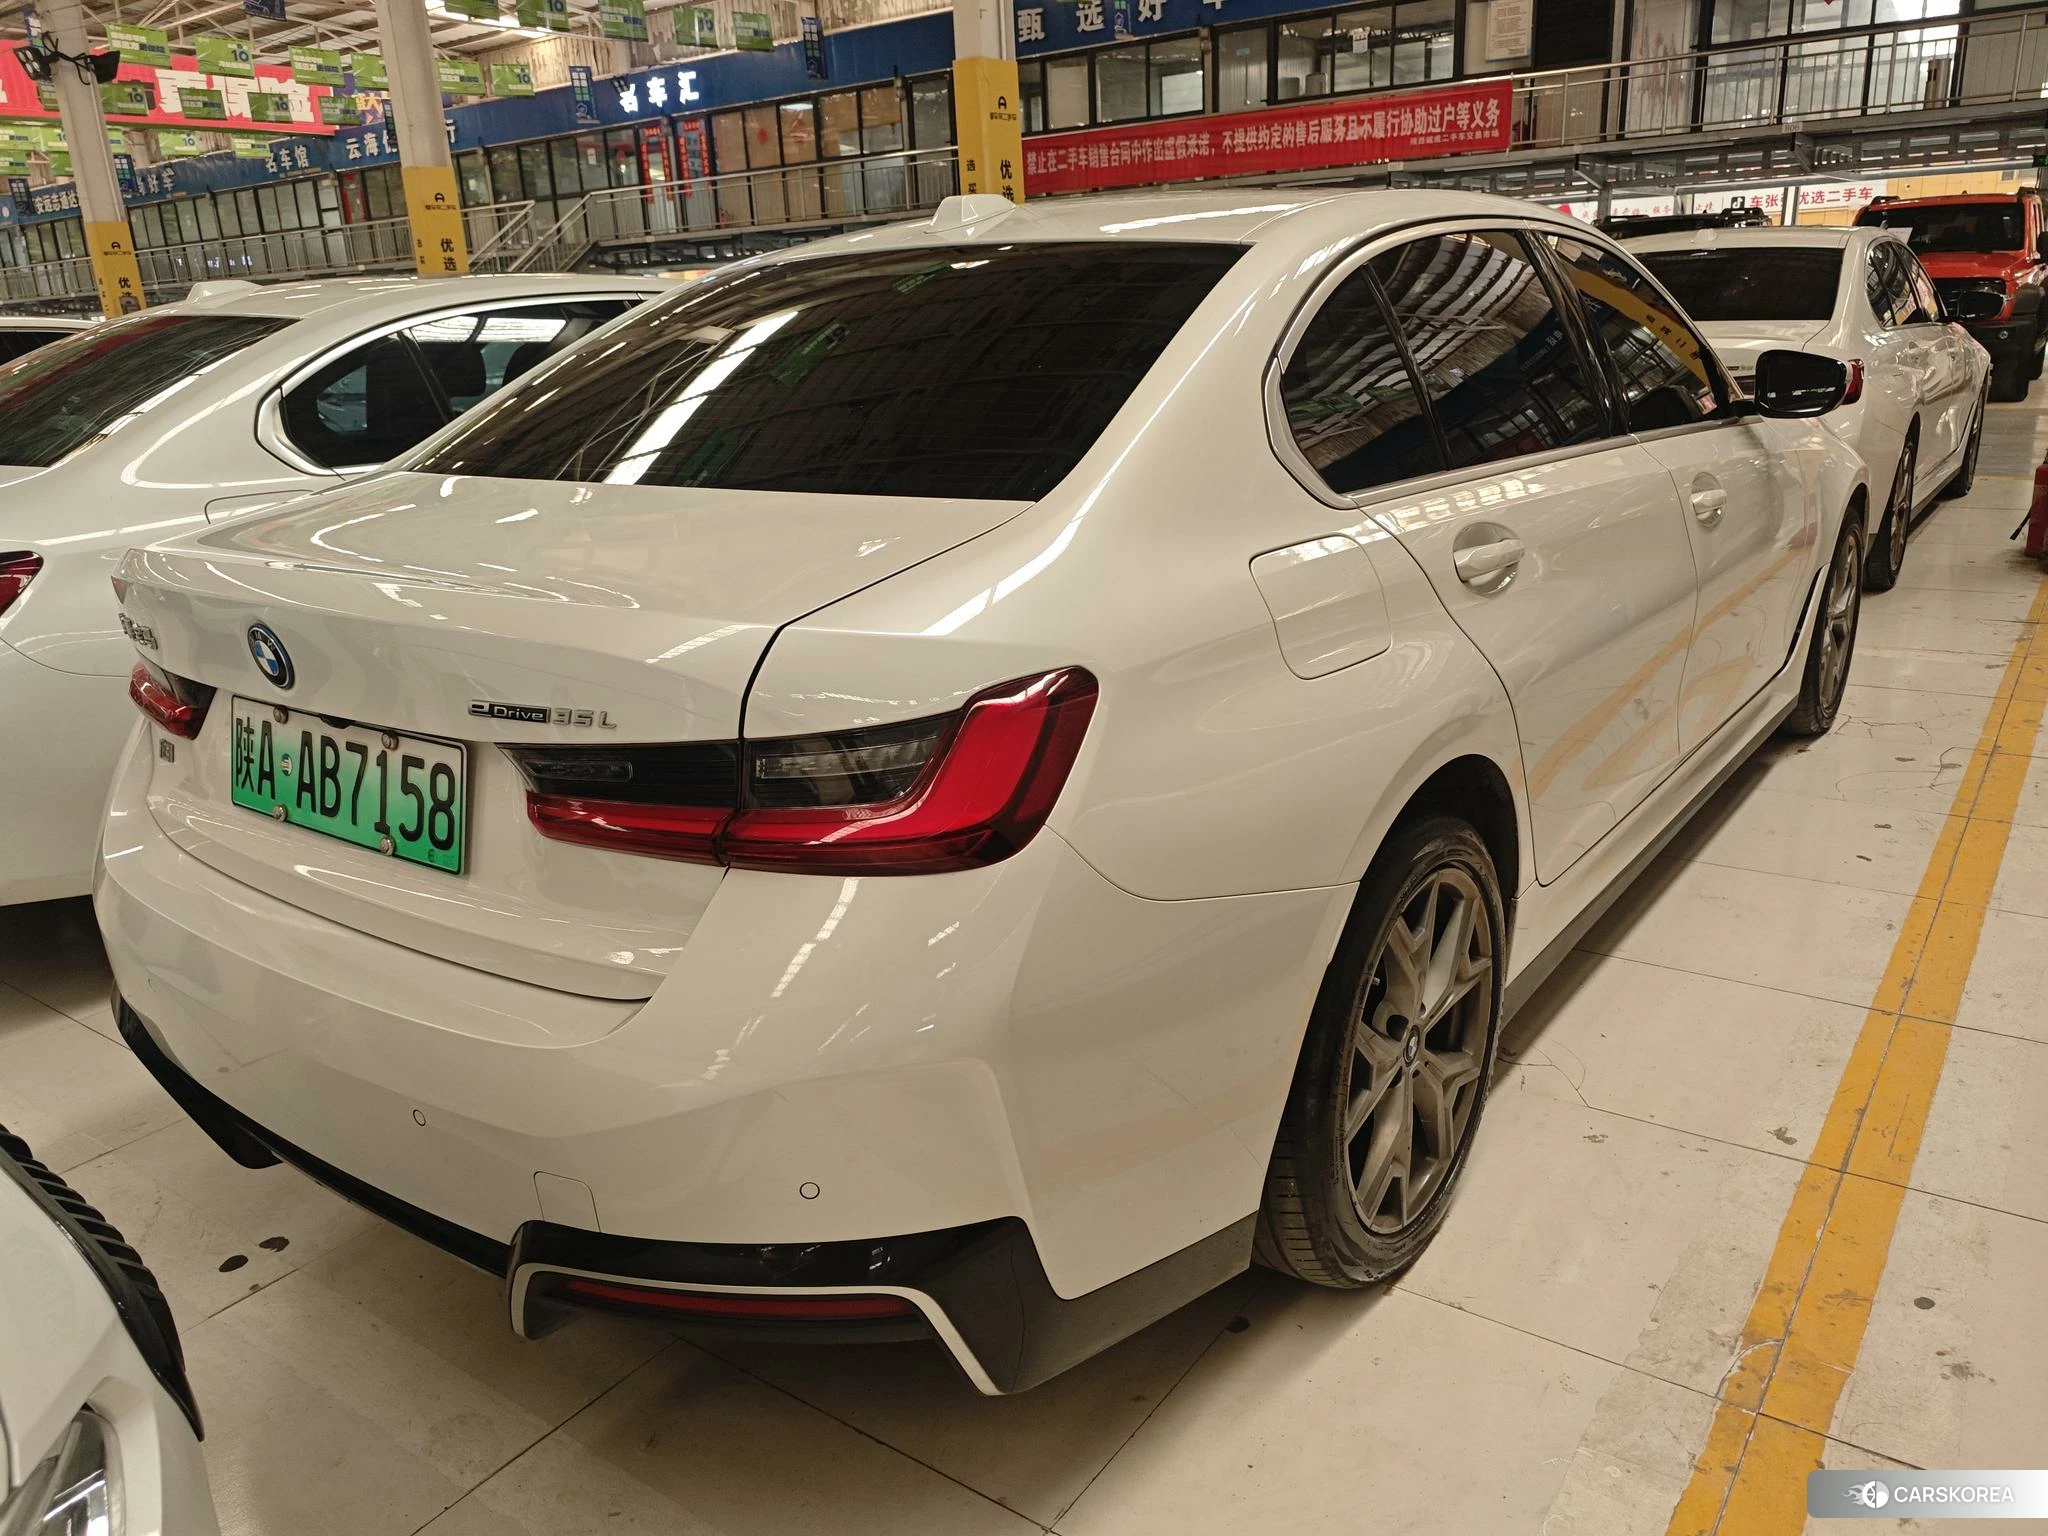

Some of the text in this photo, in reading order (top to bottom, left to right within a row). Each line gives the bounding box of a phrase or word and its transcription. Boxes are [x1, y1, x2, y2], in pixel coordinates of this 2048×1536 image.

[230, 49, 249, 63] 10
[517, 71, 531, 84] 10
[126, 90, 144, 103] 10
[275, 100, 290, 111] 10
[1750, 186, 1874, 208] 车张优选二手车
[440, 238, 457, 271] 优选
